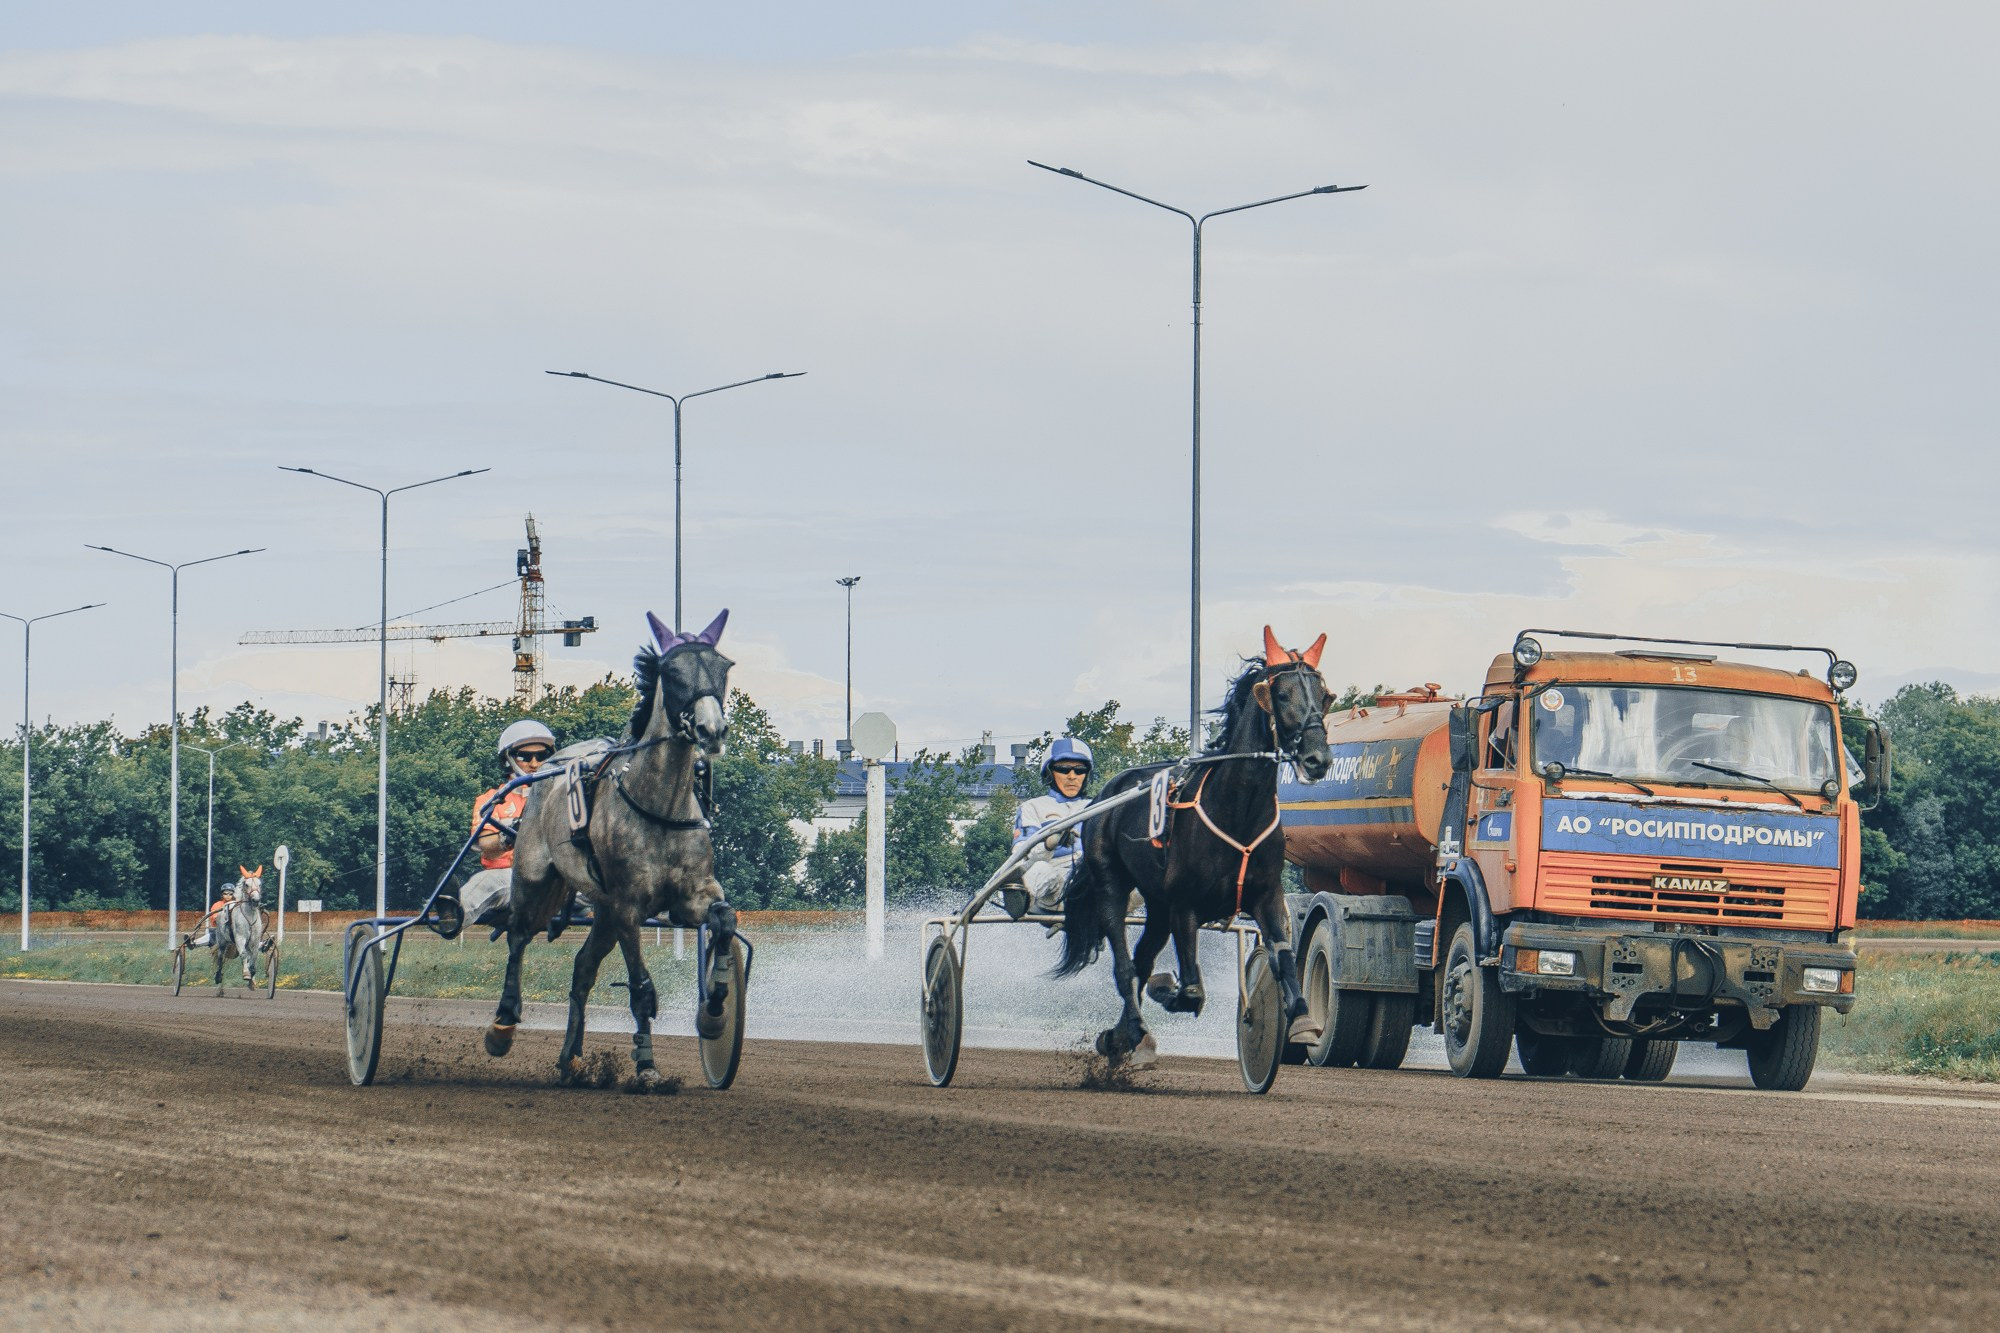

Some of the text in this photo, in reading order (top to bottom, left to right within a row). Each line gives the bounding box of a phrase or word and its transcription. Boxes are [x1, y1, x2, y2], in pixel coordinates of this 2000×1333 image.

[1672, 666, 1697, 682] 13
[1154, 777, 1162, 831] 3
[1556, 815, 1591, 834] АО
[1654, 877, 1728, 893] KAMAZ
